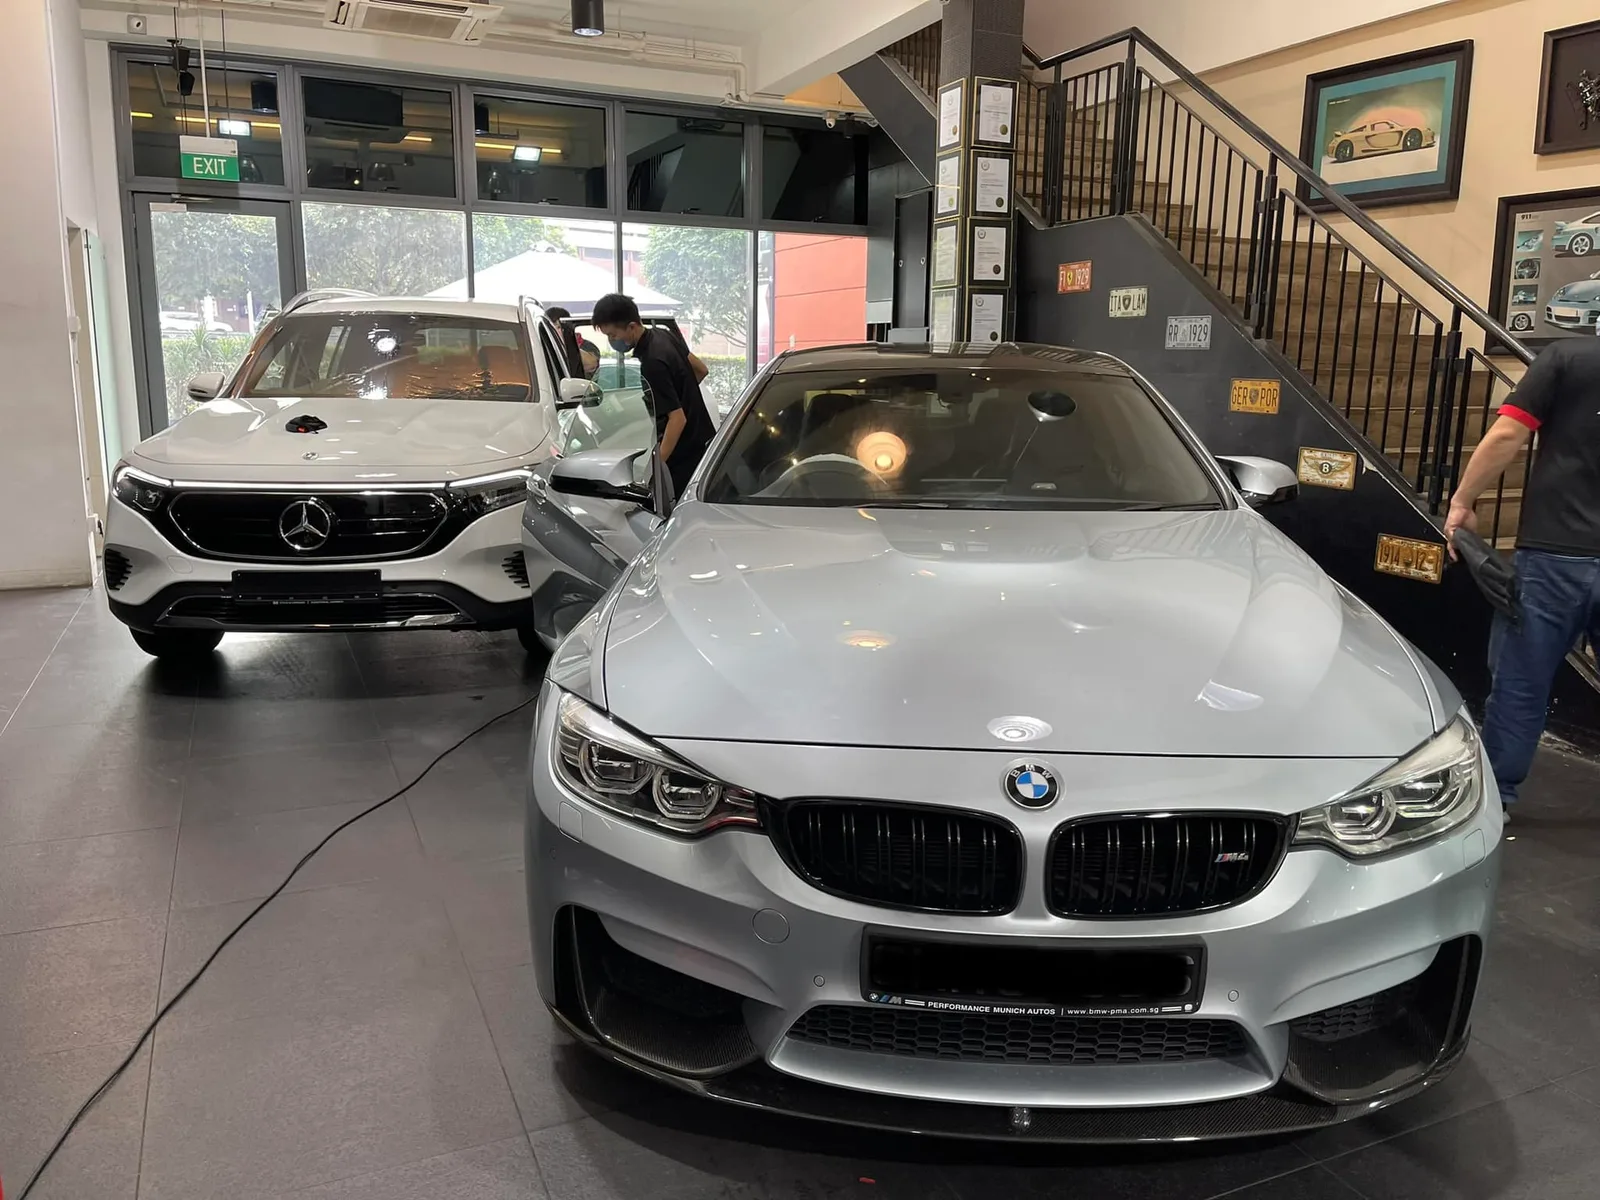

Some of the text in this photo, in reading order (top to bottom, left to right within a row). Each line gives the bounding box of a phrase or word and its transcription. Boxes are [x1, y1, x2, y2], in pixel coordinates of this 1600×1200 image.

[193, 156, 227, 176] EXIT
[1110, 293, 1147, 312] ITA LAM
[1168, 323, 1209, 342] RR 1929
[1231, 386, 1279, 407] GER POR
[1379, 543, 1400, 566] 1914
[1010, 764, 1053, 779] BMW
[927, 1001, 991, 1013] PERFORMANCE
[993, 1006, 1026, 1015] MUNICH
[1026, 1008, 1056, 1016] AUTOS
[1067, 1007, 1159, 1016] www.bmw-pma.com.sg
